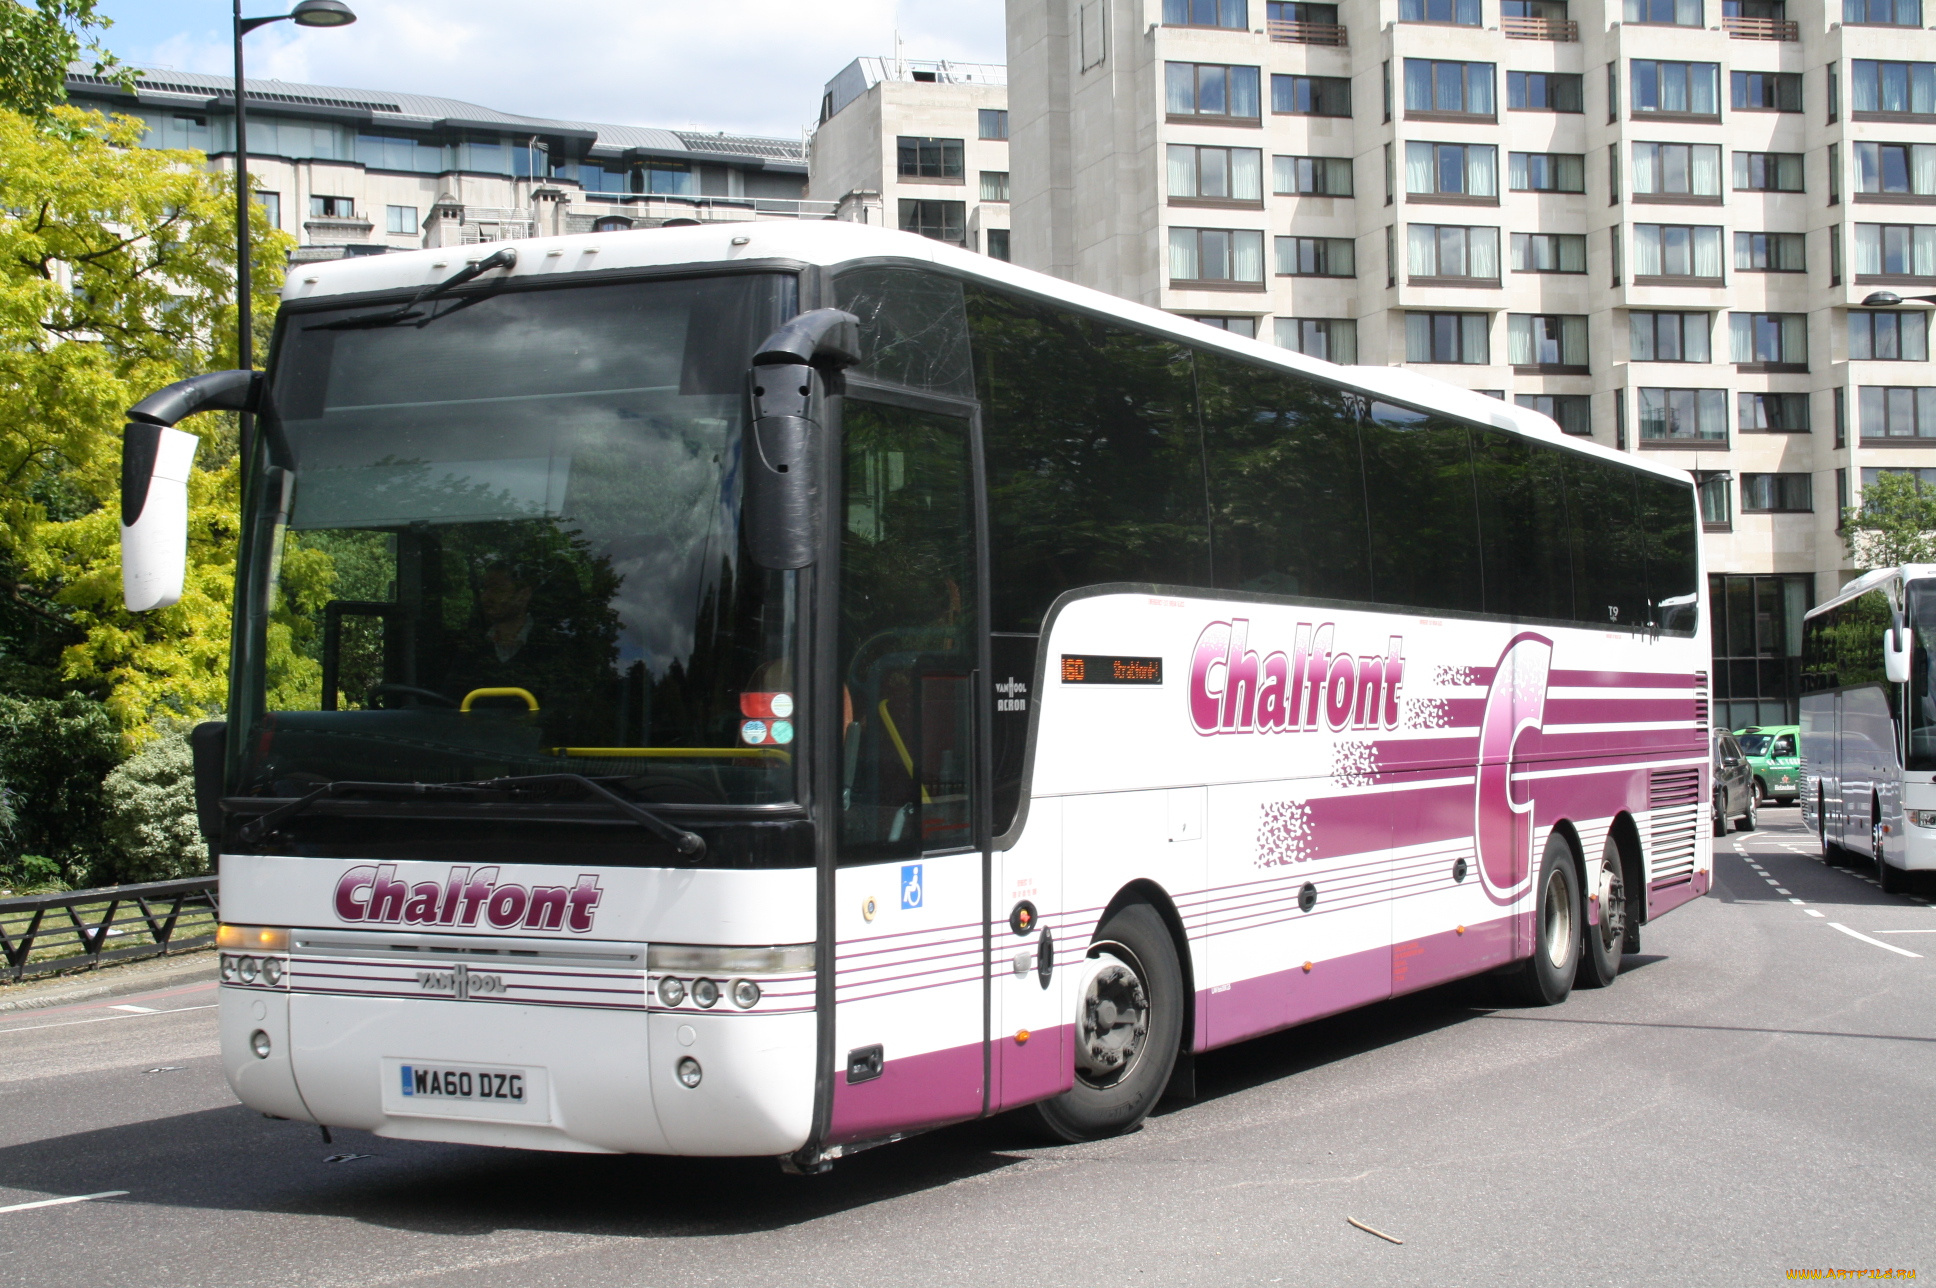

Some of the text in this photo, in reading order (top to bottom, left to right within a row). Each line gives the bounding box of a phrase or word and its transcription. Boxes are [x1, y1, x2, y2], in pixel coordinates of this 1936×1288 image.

[1608, 605, 1619, 617] T9
[1187, 618, 1405, 737] Chalfont
[332, 864, 604, 933] Chalfont
[415, 1070, 523, 1099] WA60 DZG
